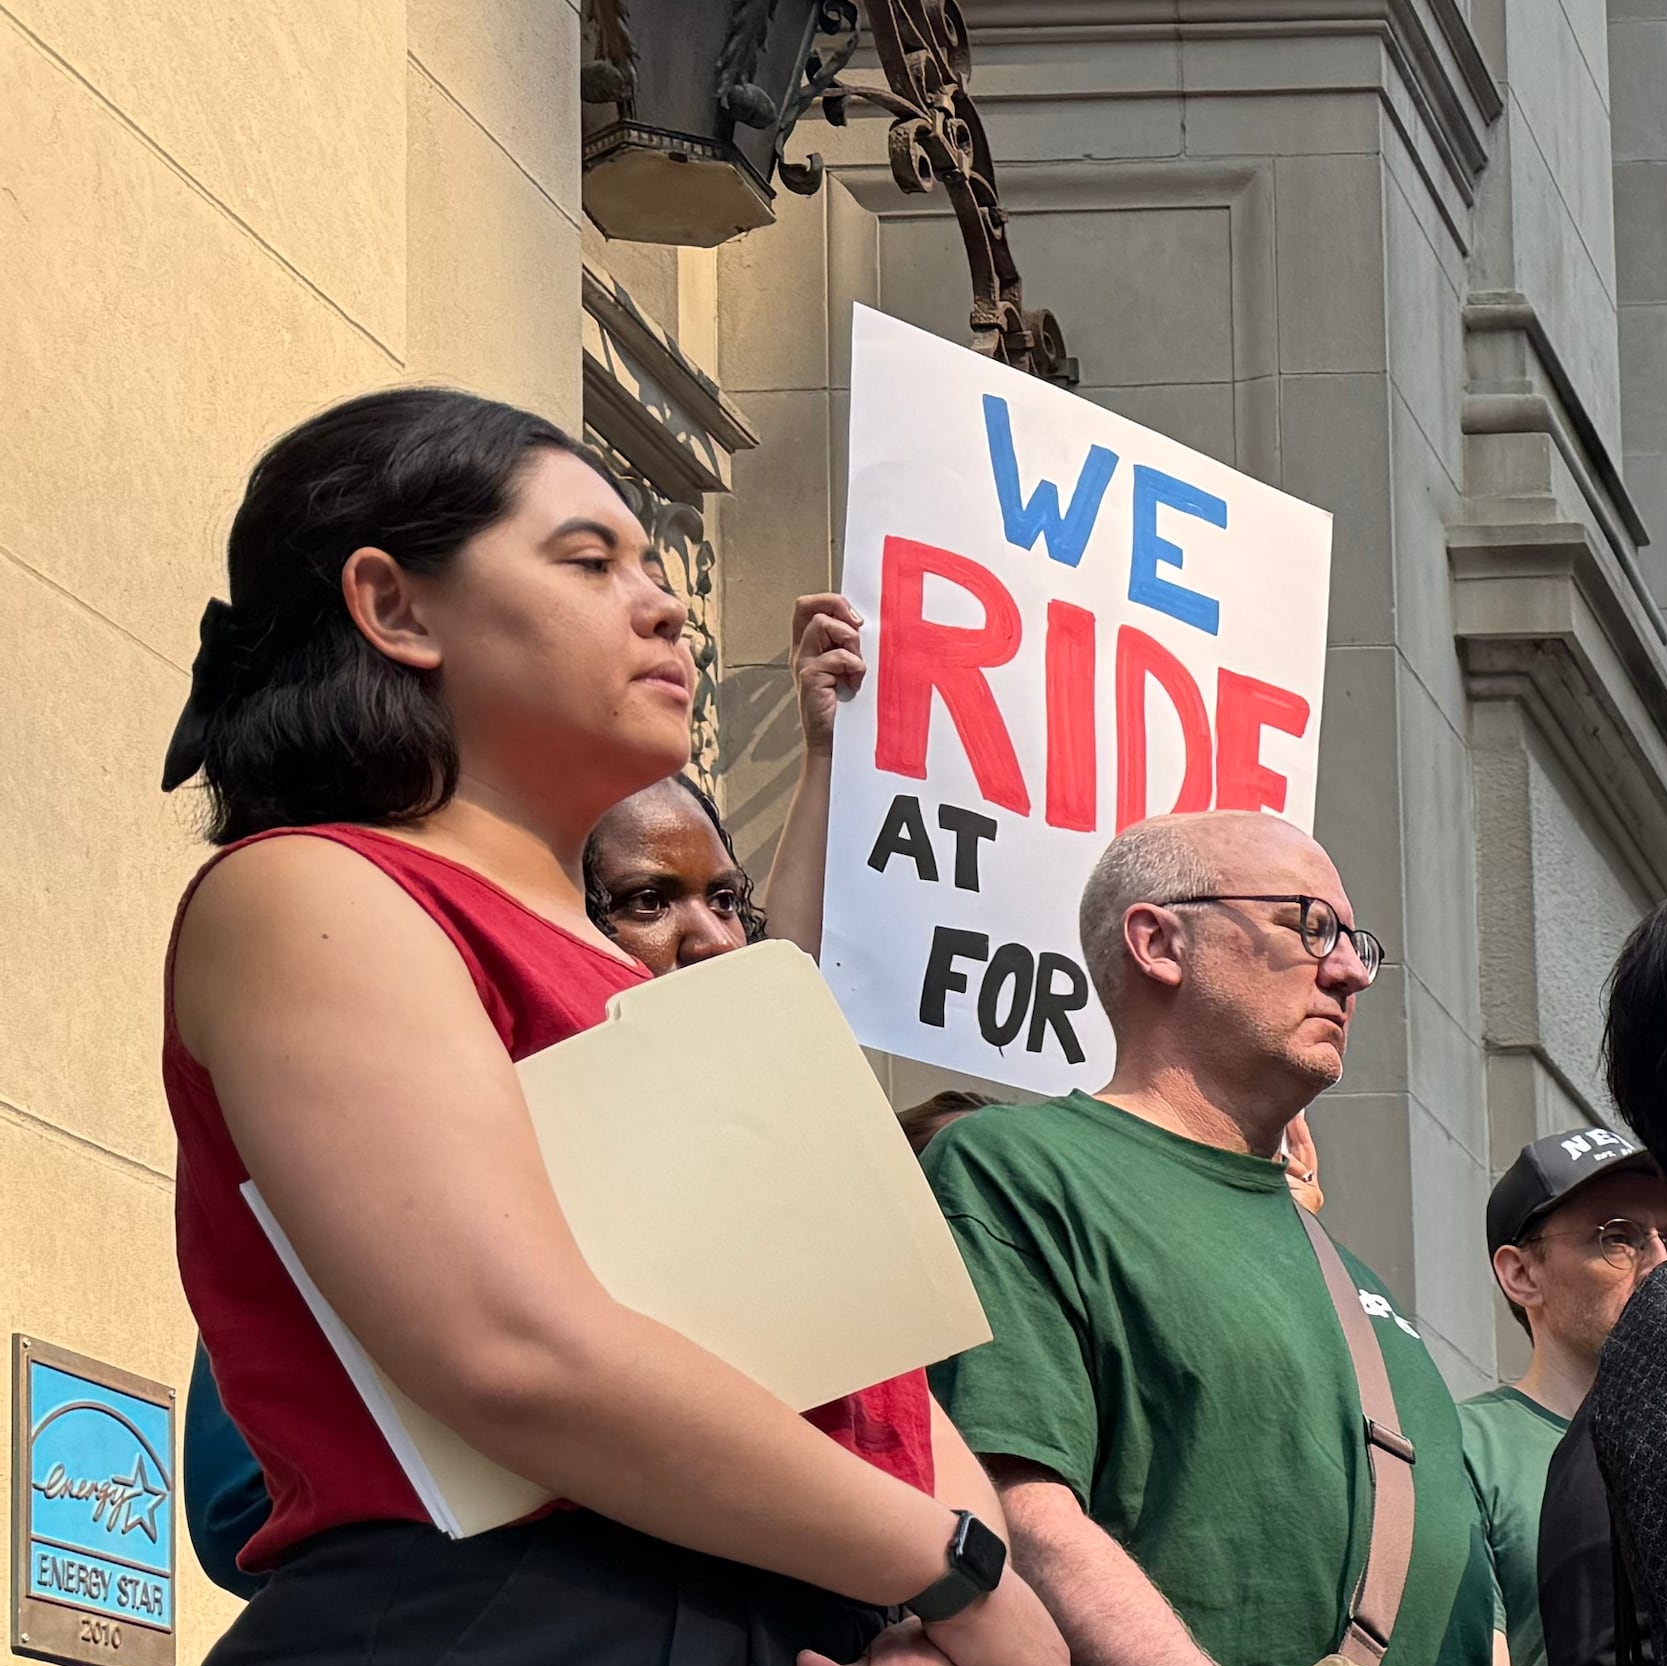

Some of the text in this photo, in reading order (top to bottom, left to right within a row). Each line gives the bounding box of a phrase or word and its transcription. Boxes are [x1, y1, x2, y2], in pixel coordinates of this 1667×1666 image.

[982, 394, 1228, 637] WE
[874, 535, 1312, 835] RIDE
[866, 794, 998, 893] AT
[919, 925, 1090, 1066] FOR
[33, 1462, 143, 1533] energy
[37, 1553, 164, 1616] ENERGY STAR
[80, 1618, 122, 1649] 2010
